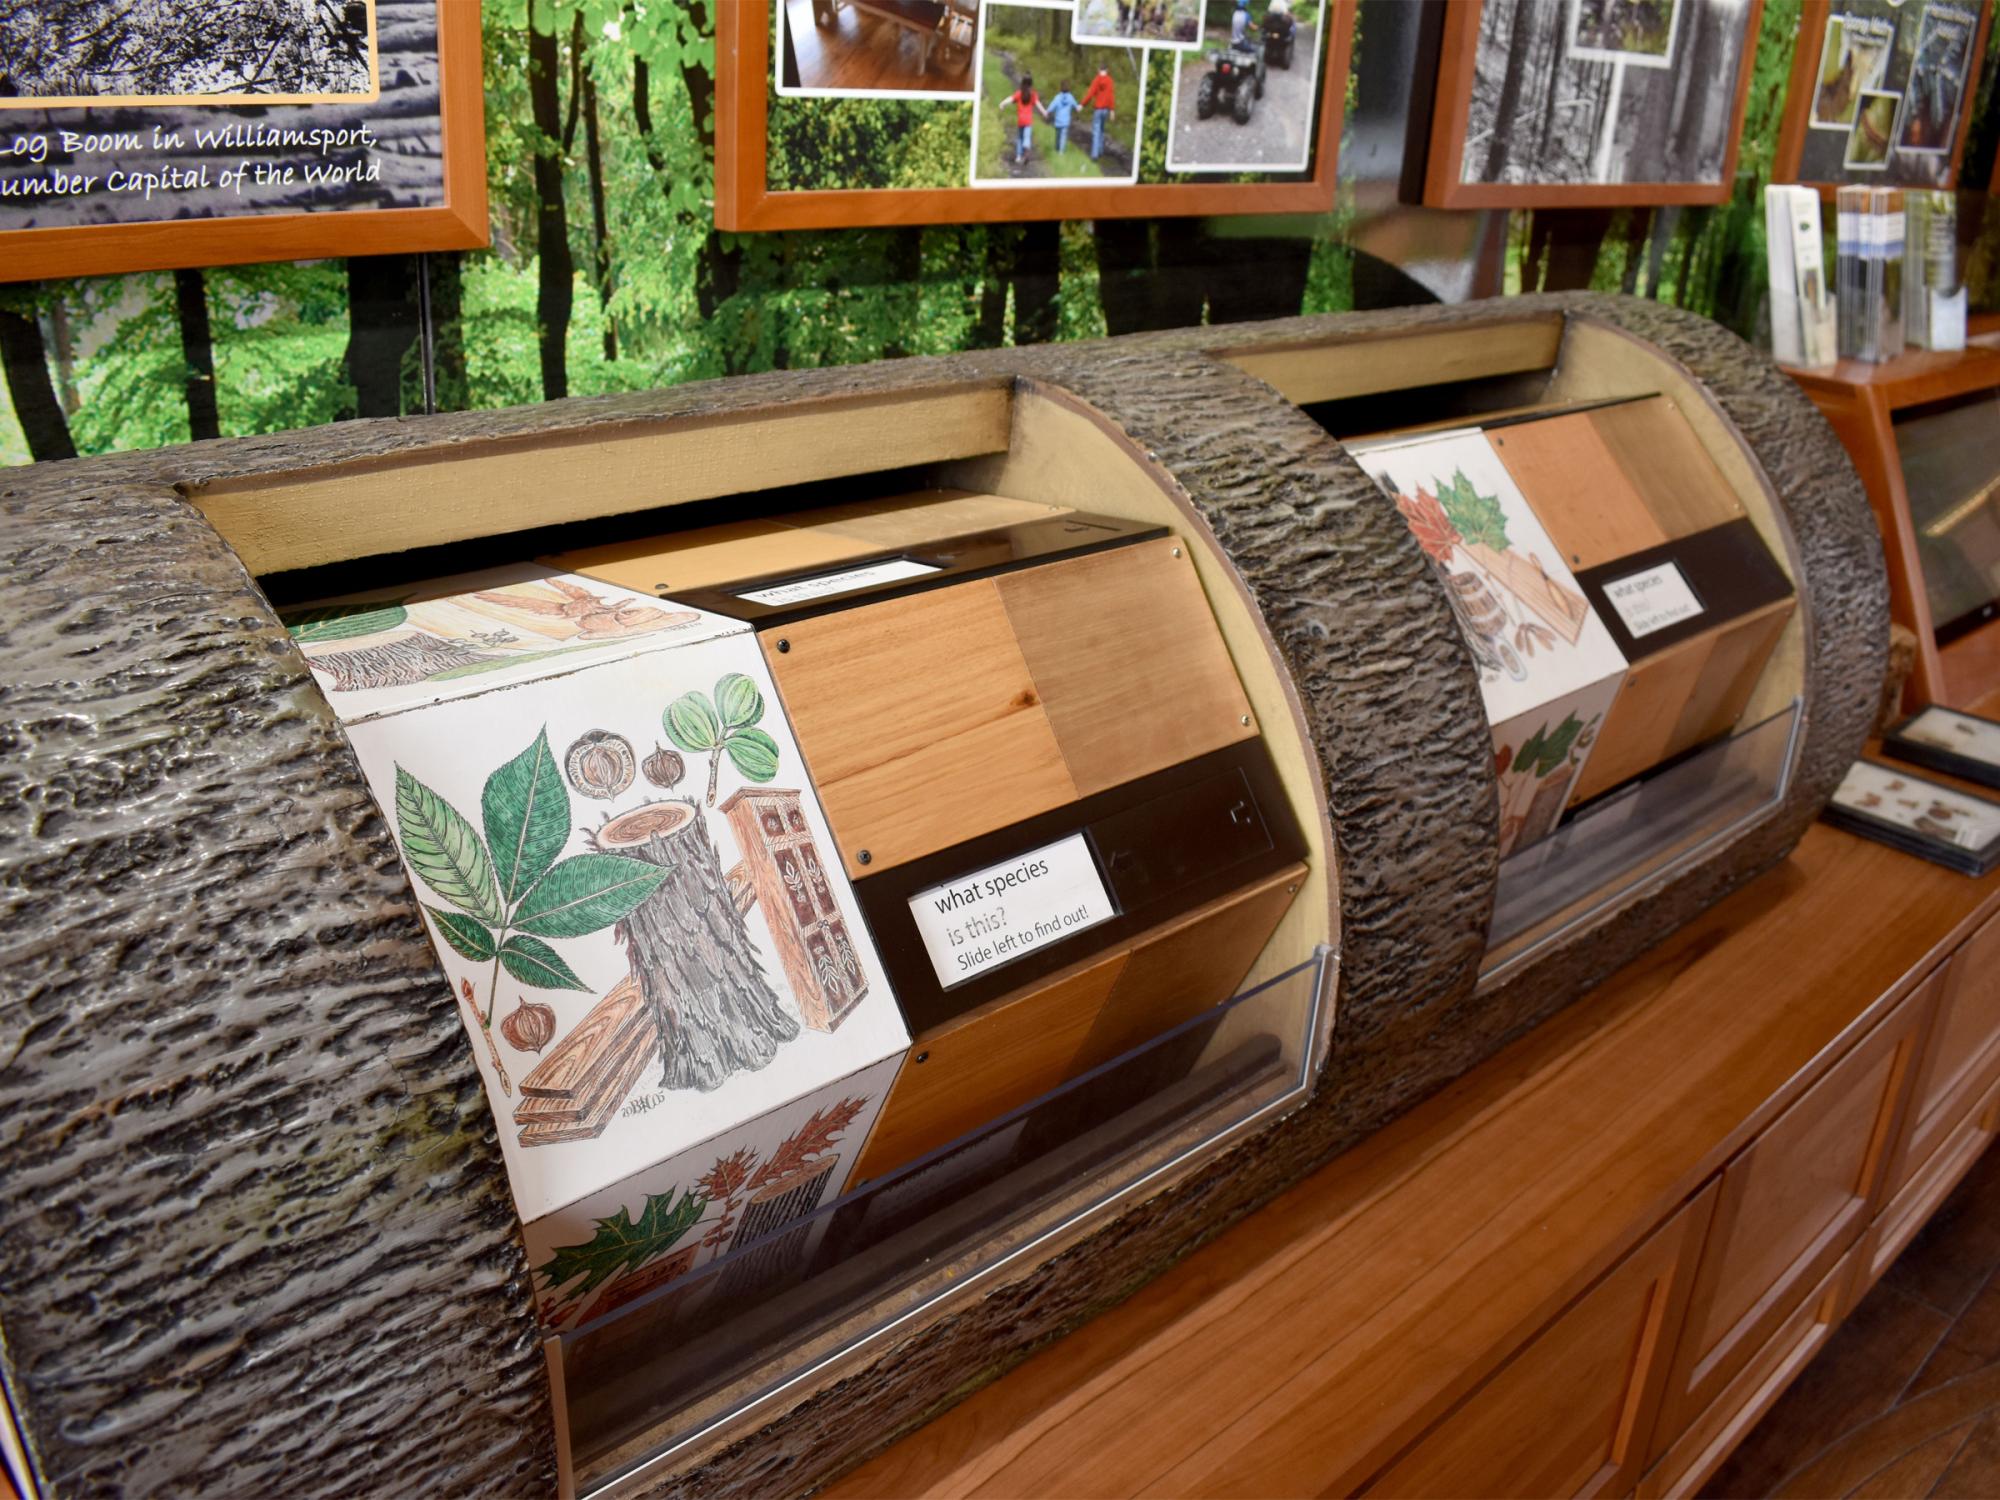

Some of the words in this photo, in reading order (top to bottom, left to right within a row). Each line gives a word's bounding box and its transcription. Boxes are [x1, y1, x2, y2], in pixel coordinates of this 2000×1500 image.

[60, 131, 143, 153] Boom
[153, 125, 185, 150] in
[195, 123, 377, 155] Williamsport,
[0, 169, 99, 196] umber
[108, 165, 210, 200] Capital
[219, 161, 250, 195] of
[254, 163, 294, 185] the
[304, 158, 381, 184] World
[935, 883, 983, 914] what
[985, 860, 1049, 897] species
[946, 928, 964, 947] is
[965, 907, 1007, 939] this?
[957, 947, 992, 971] Slide
[993, 935, 1018, 955] left
[1019, 932, 1034, 945] to
[1034, 915, 1061, 938] find
[1063, 904, 1089, 926] out!
